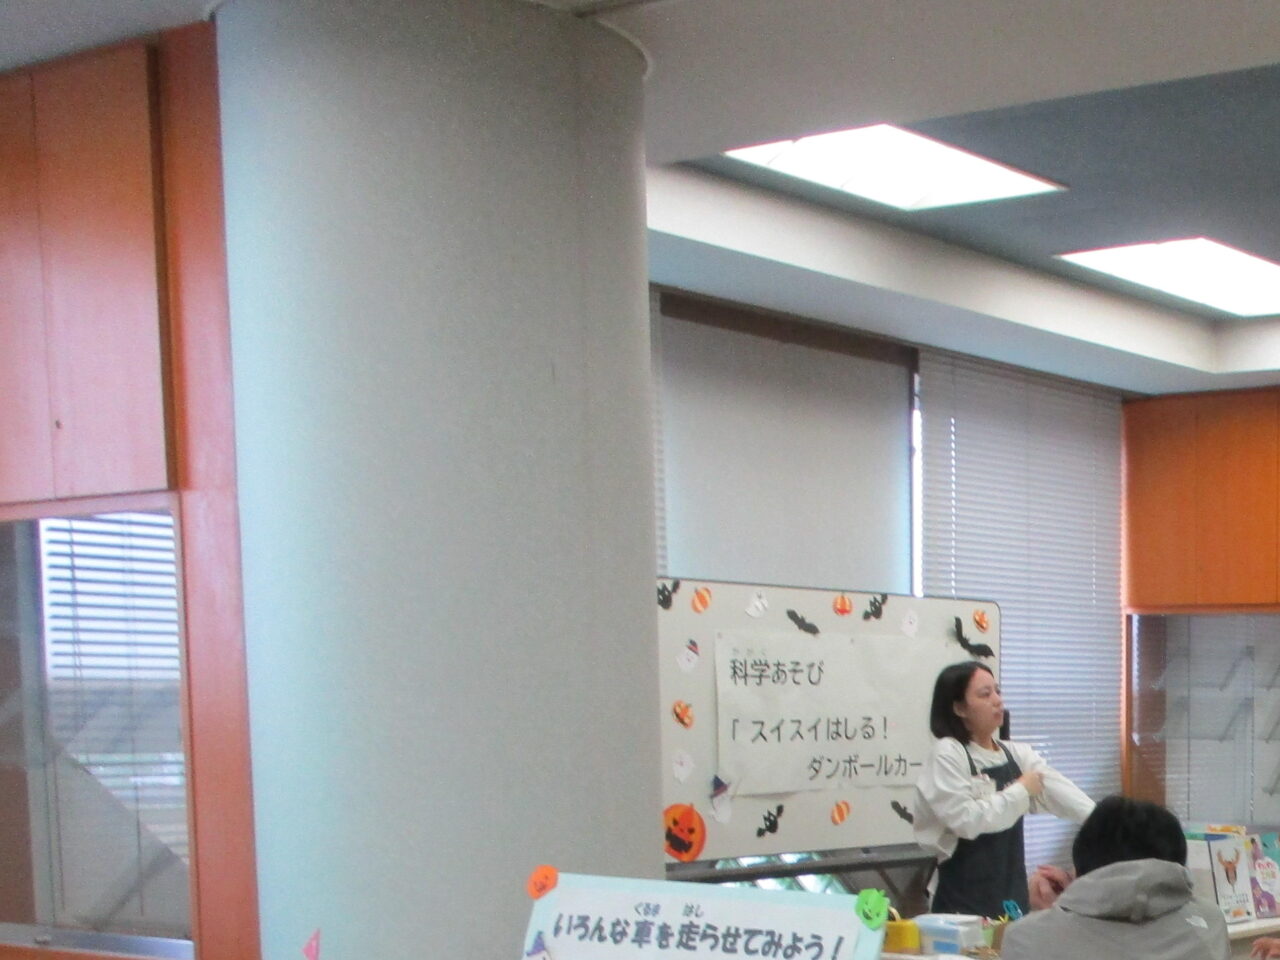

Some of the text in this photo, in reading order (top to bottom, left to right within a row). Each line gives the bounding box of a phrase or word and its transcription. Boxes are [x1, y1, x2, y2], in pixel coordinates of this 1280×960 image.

[730, 658, 825, 686] 科学あそび
[808, 753, 923, 781] ダンボールカー
